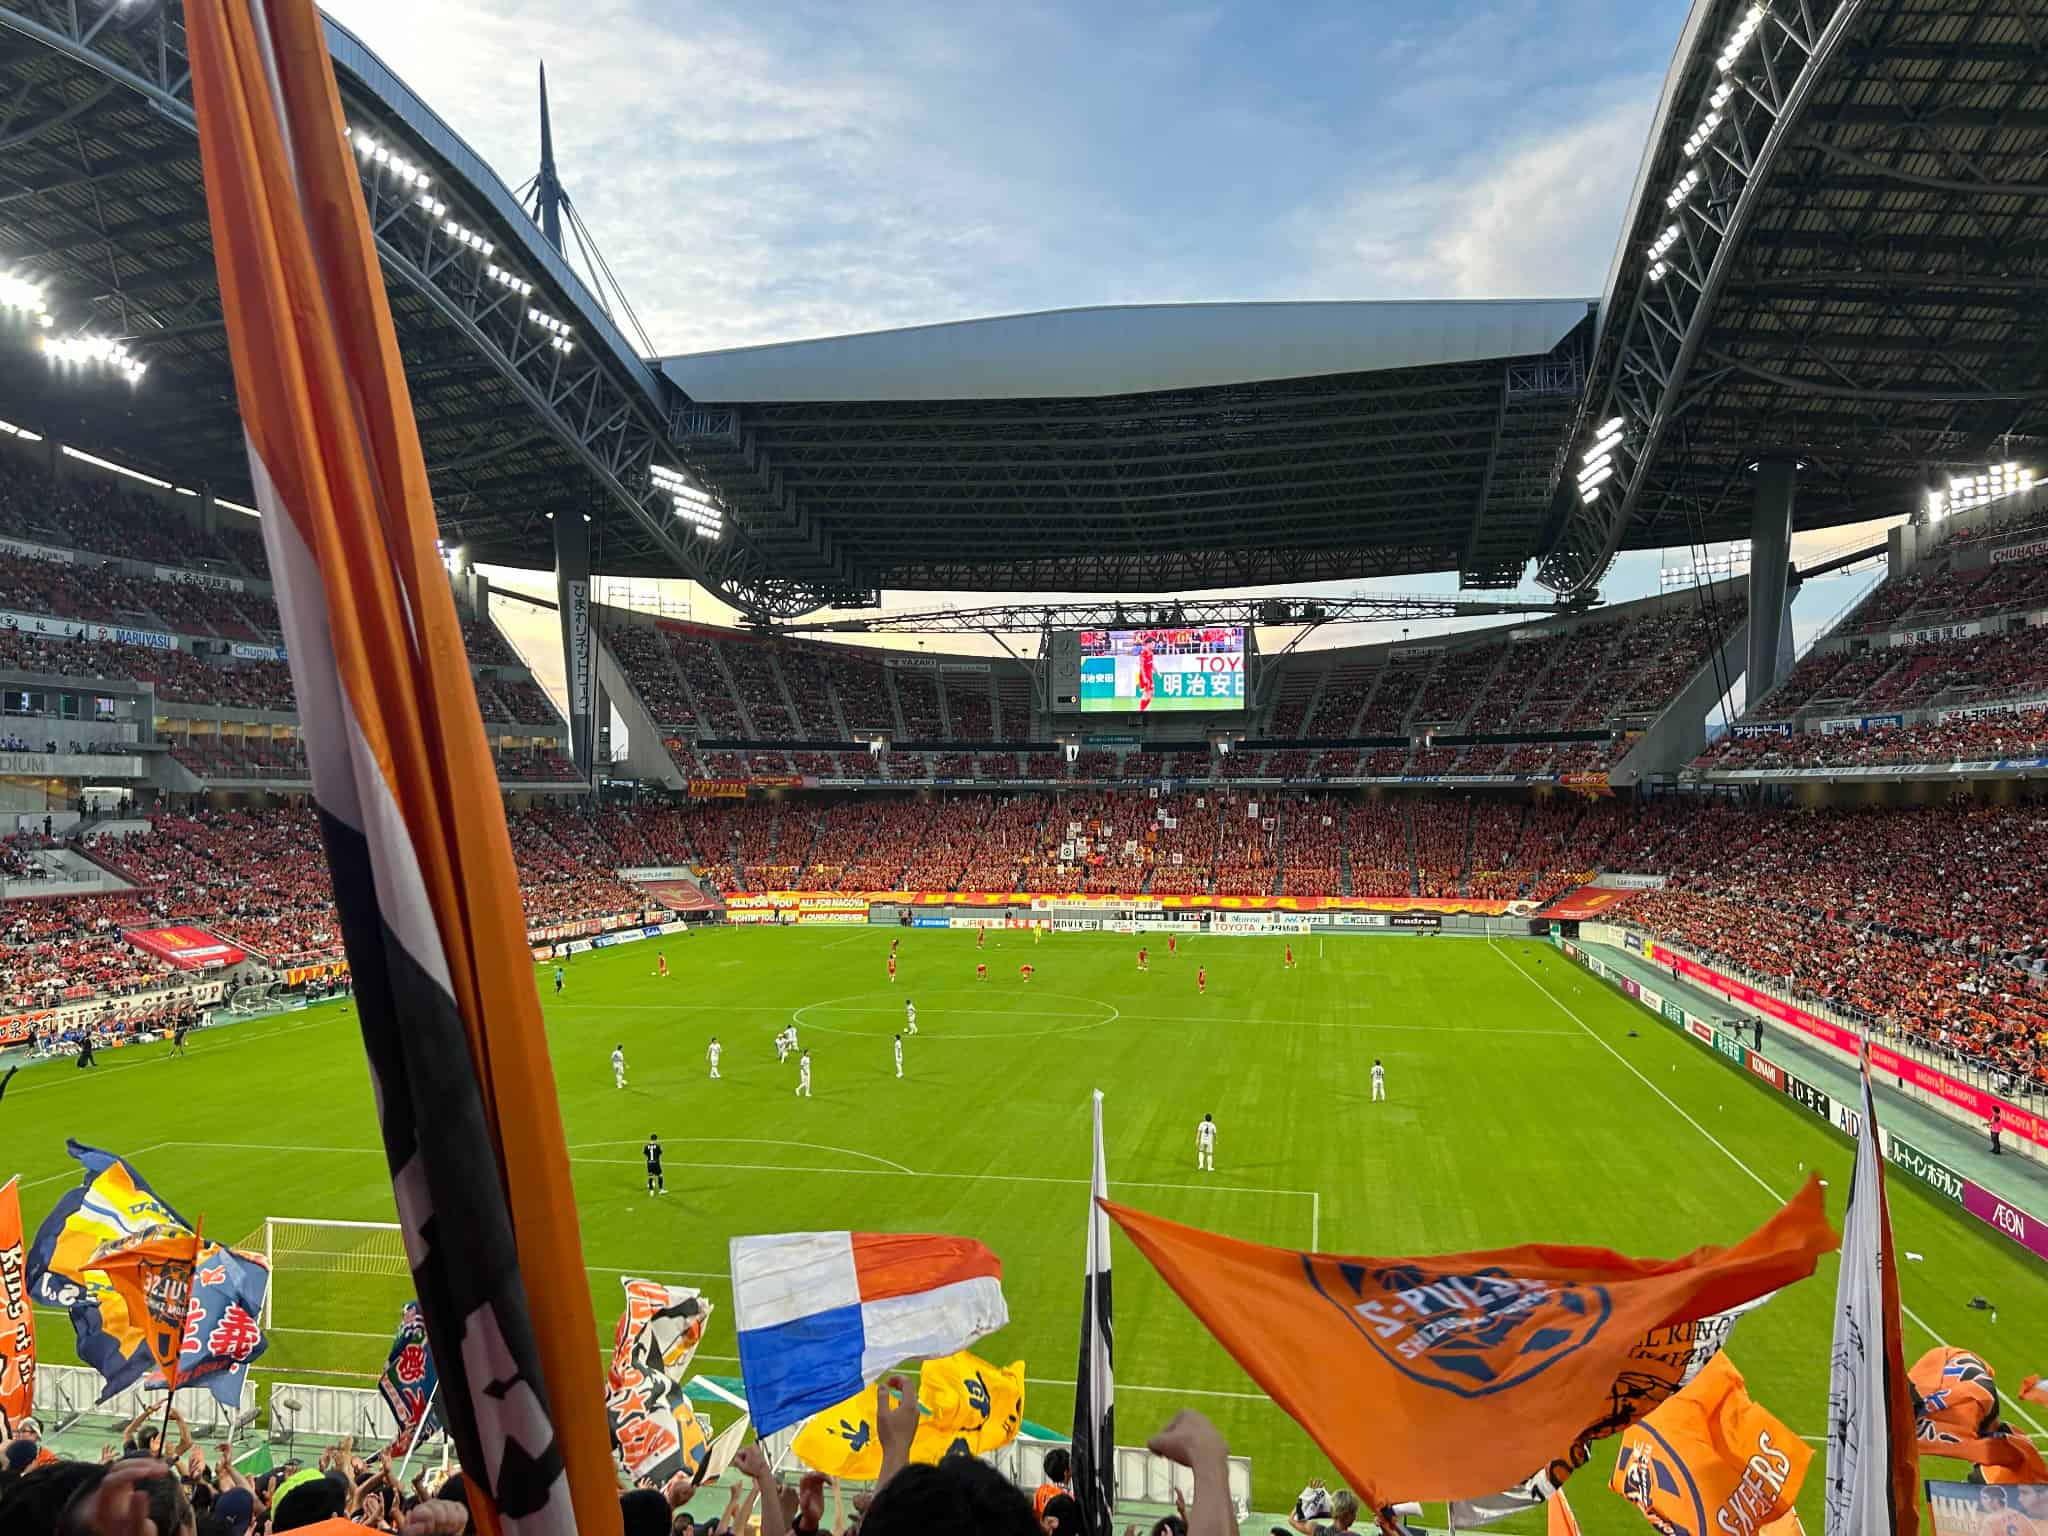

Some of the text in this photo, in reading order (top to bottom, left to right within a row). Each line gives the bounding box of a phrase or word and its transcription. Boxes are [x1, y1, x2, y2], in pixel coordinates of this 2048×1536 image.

[116, 629, 170, 650] MARUYASU
[1196, 656, 1243, 672] TOY
[1214, 923, 1256, 931] TOYOTA
[1751, 1056, 1776, 1082] KONAMI
[1796, 1081, 1825, 1116] いちご
[1839, 1106, 1862, 1138] AID
